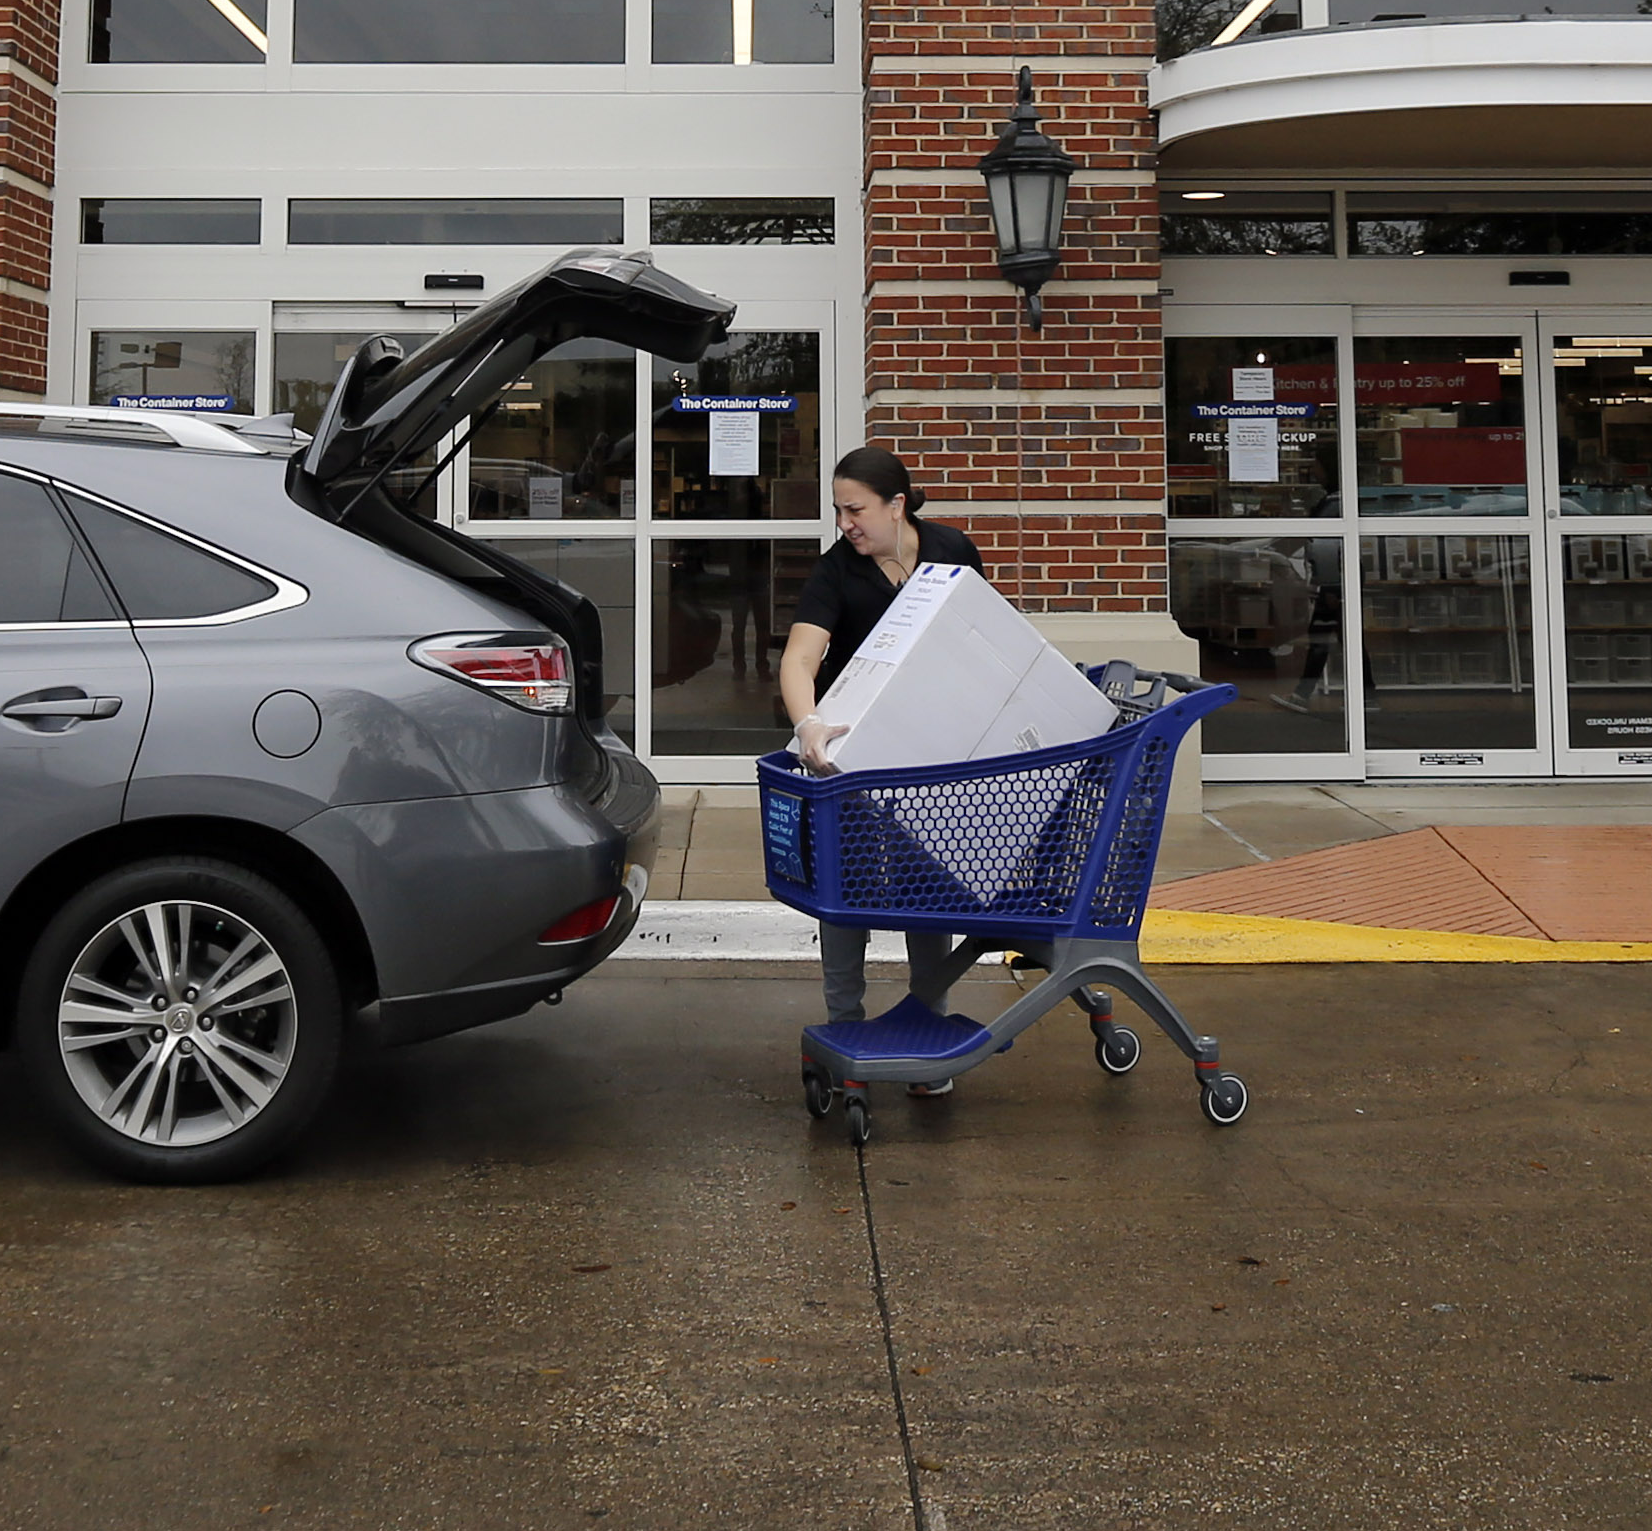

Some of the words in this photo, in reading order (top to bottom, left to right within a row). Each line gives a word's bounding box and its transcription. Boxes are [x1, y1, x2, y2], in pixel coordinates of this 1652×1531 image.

[1379, 379, 1396, 391] up
[1398, 377, 1413, 388] to
[1415, 376, 1444, 388] 25%
[1447, 376, 1466, 388] off
[117, 397, 138, 408] The
[139, 396, 194, 408] Container
[195, 397, 225, 408] Store
[680, 398, 701, 409] The
[702, 398, 758, 409] Container
[759, 398, 790, 409] Store
[1197, 405, 1218, 415] The
[1219, 405, 1275, 415] Container
[1275, 405, 1306, 415] Store
[1189, 433, 1220, 442] FREE
[1278, 433, 1317, 442] ICKUP
[1489, 432, 1502, 441] up
[1504, 431, 1514, 441] to
